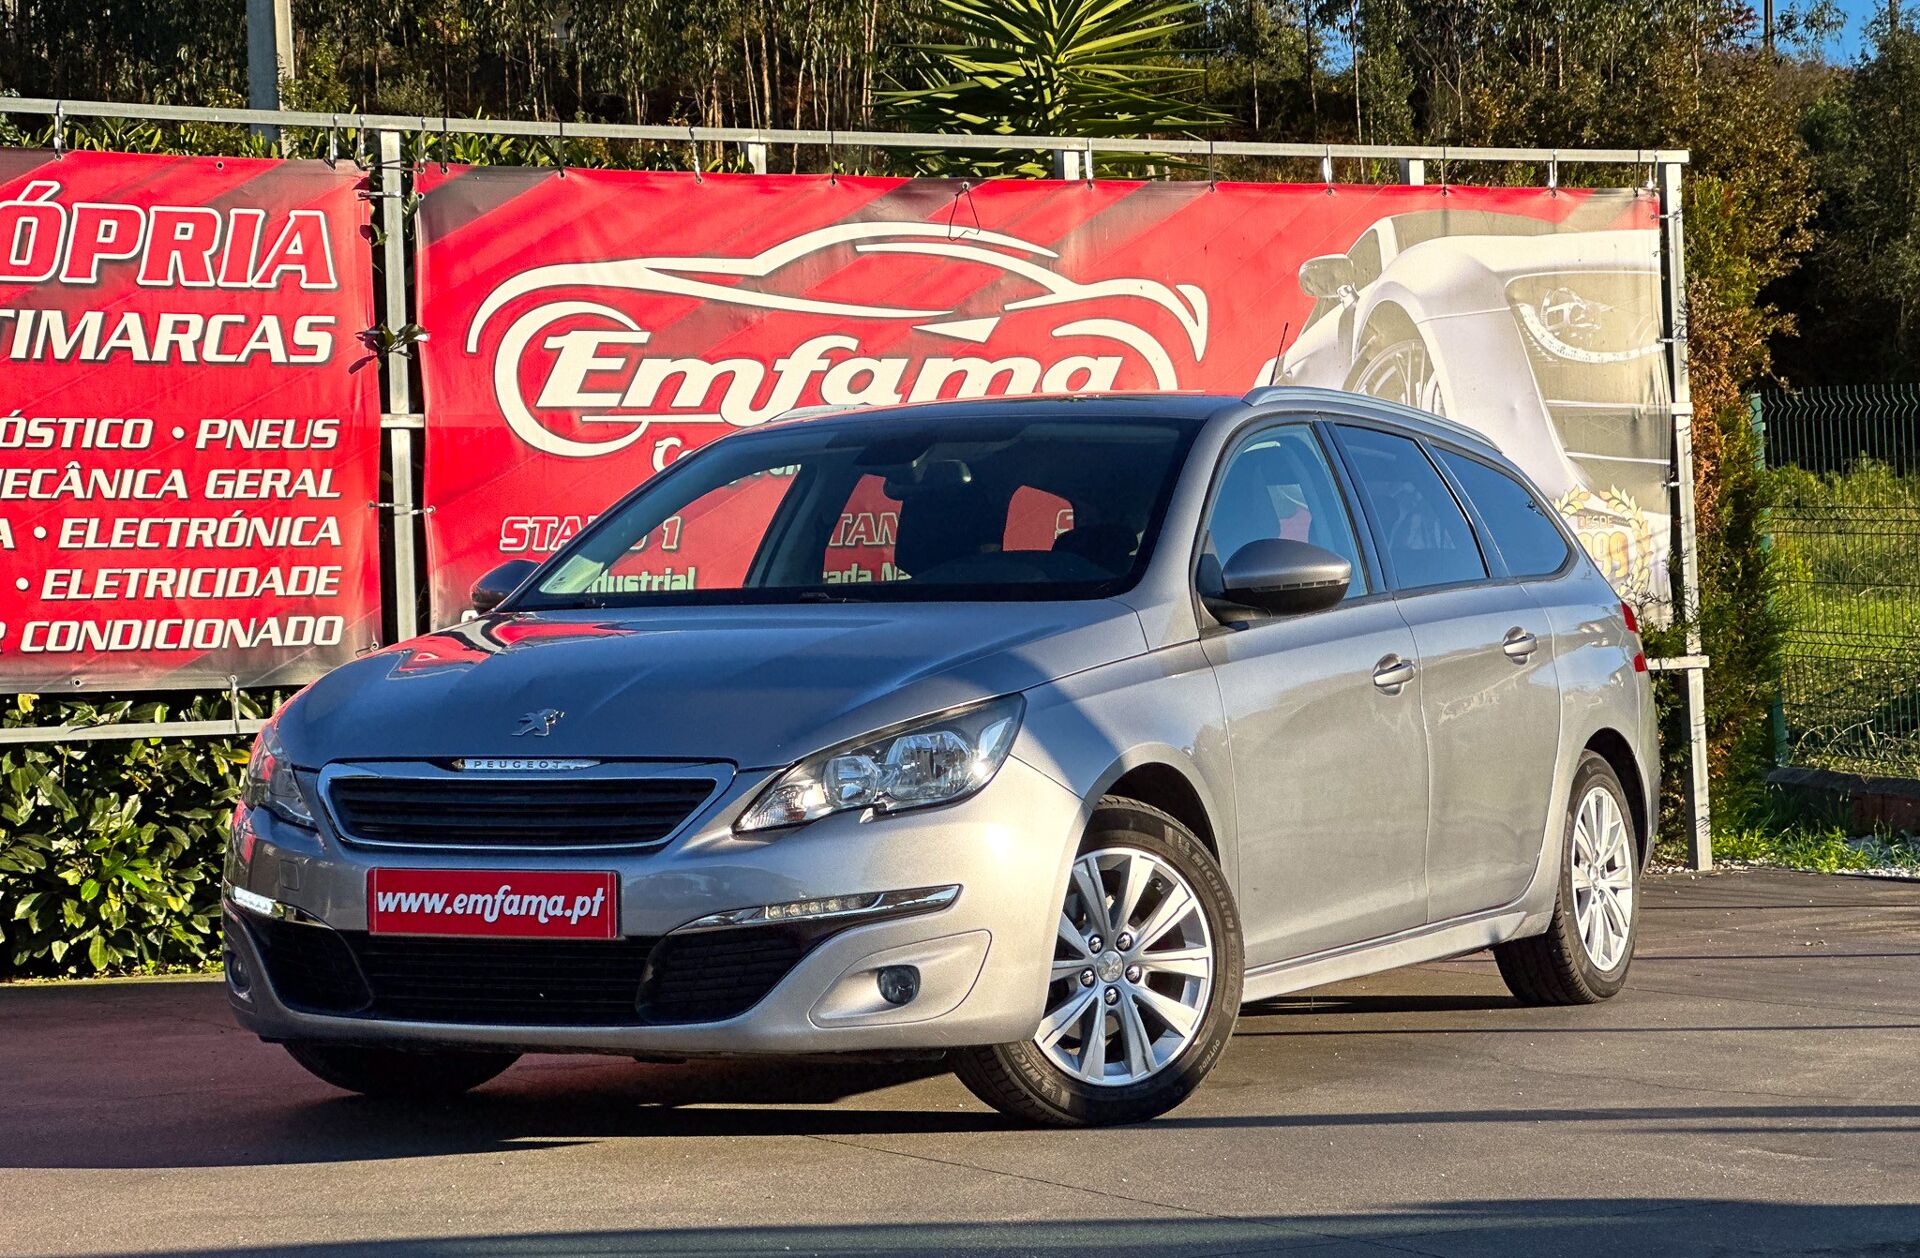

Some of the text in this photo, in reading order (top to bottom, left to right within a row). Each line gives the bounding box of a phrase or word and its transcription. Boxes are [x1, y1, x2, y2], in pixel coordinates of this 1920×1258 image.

[536, 331, 1125, 427] Emfama
[195, 418, 341, 449] PNEUS
[0, 460, 341, 500] ECÂNICA GERAL
[57, 509, 342, 548] ELECTRÓNICA
[40, 565, 342, 600] ELETRICIDADE
[20, 615, 343, 652] CONDICIONADO
[473, 760, 561, 769] PEUGEOT
[377, 884, 605, 925] www.emfama.pt
